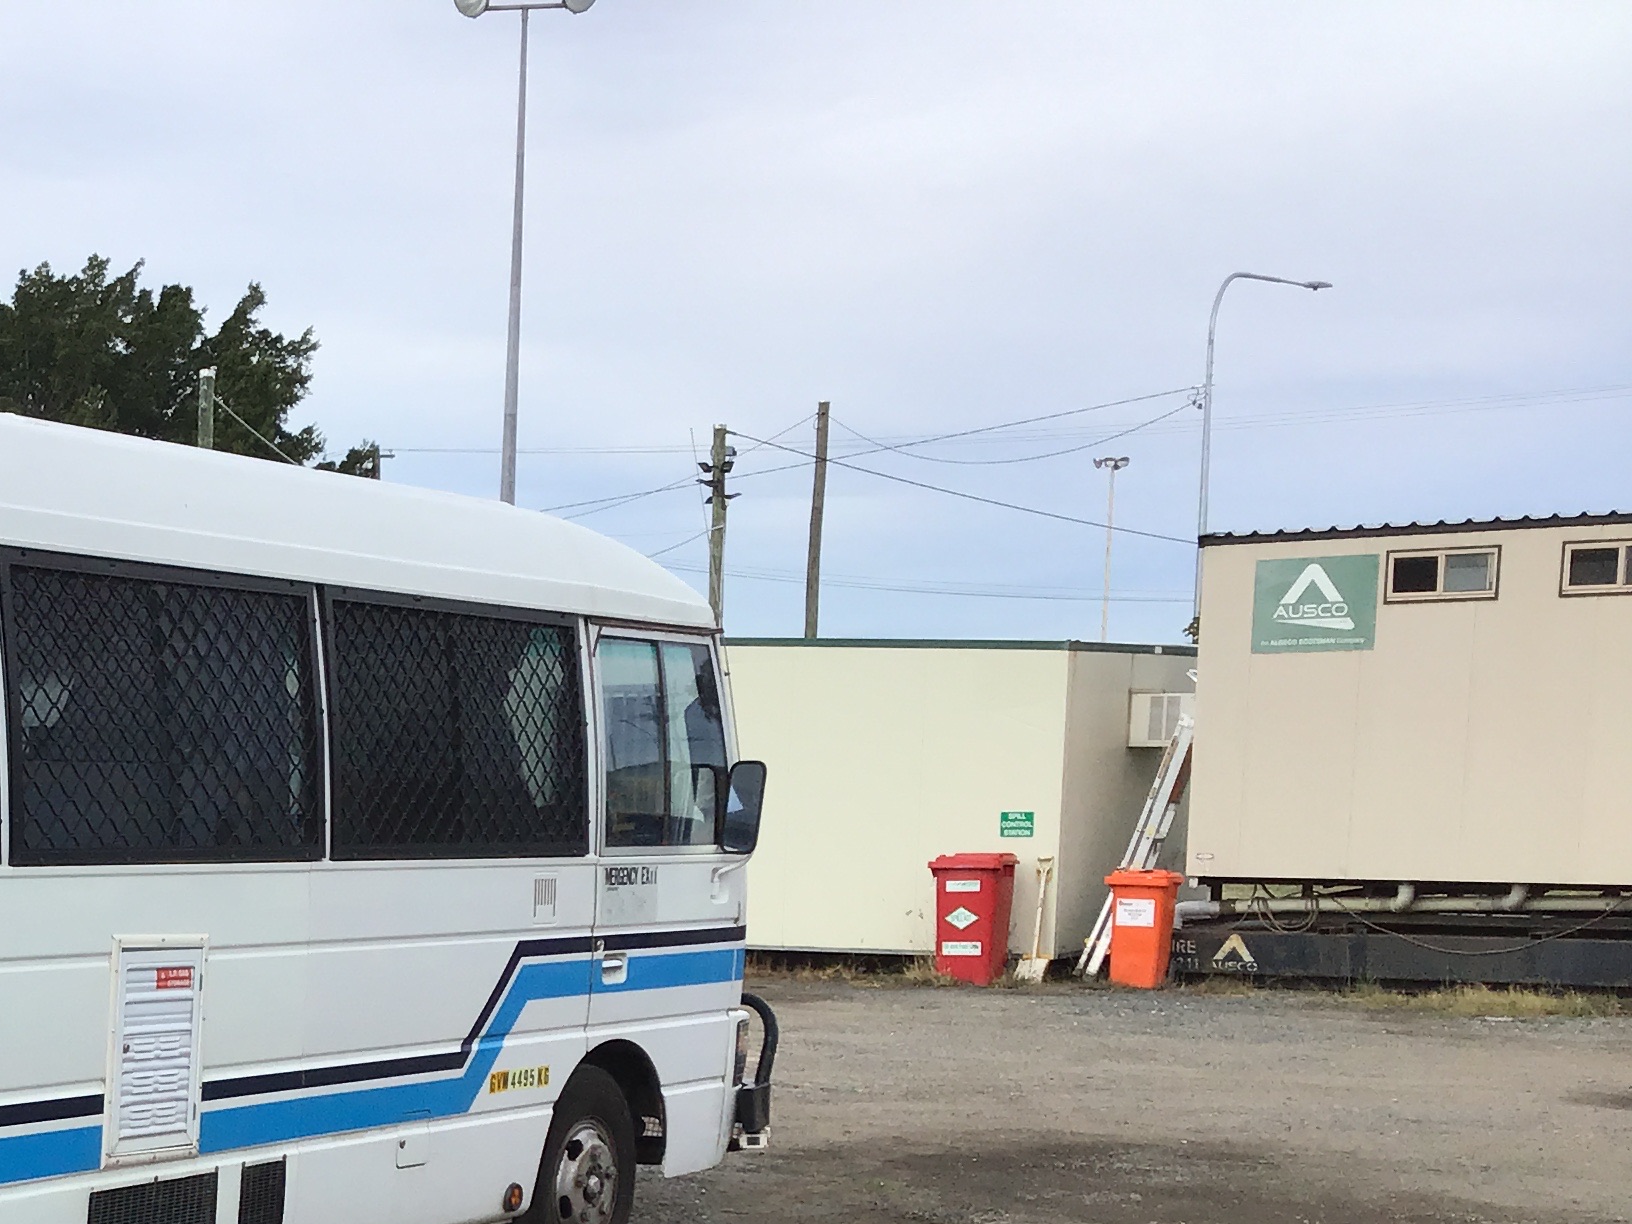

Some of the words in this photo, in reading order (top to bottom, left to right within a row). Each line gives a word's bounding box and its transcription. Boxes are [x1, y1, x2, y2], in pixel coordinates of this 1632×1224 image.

[1272, 602, 1349, 620] AUSCO
[1172, 939, 1197, 954] IRE
[511, 1068, 535, 1089] 4495
[537, 1066, 550, 1088] KG
